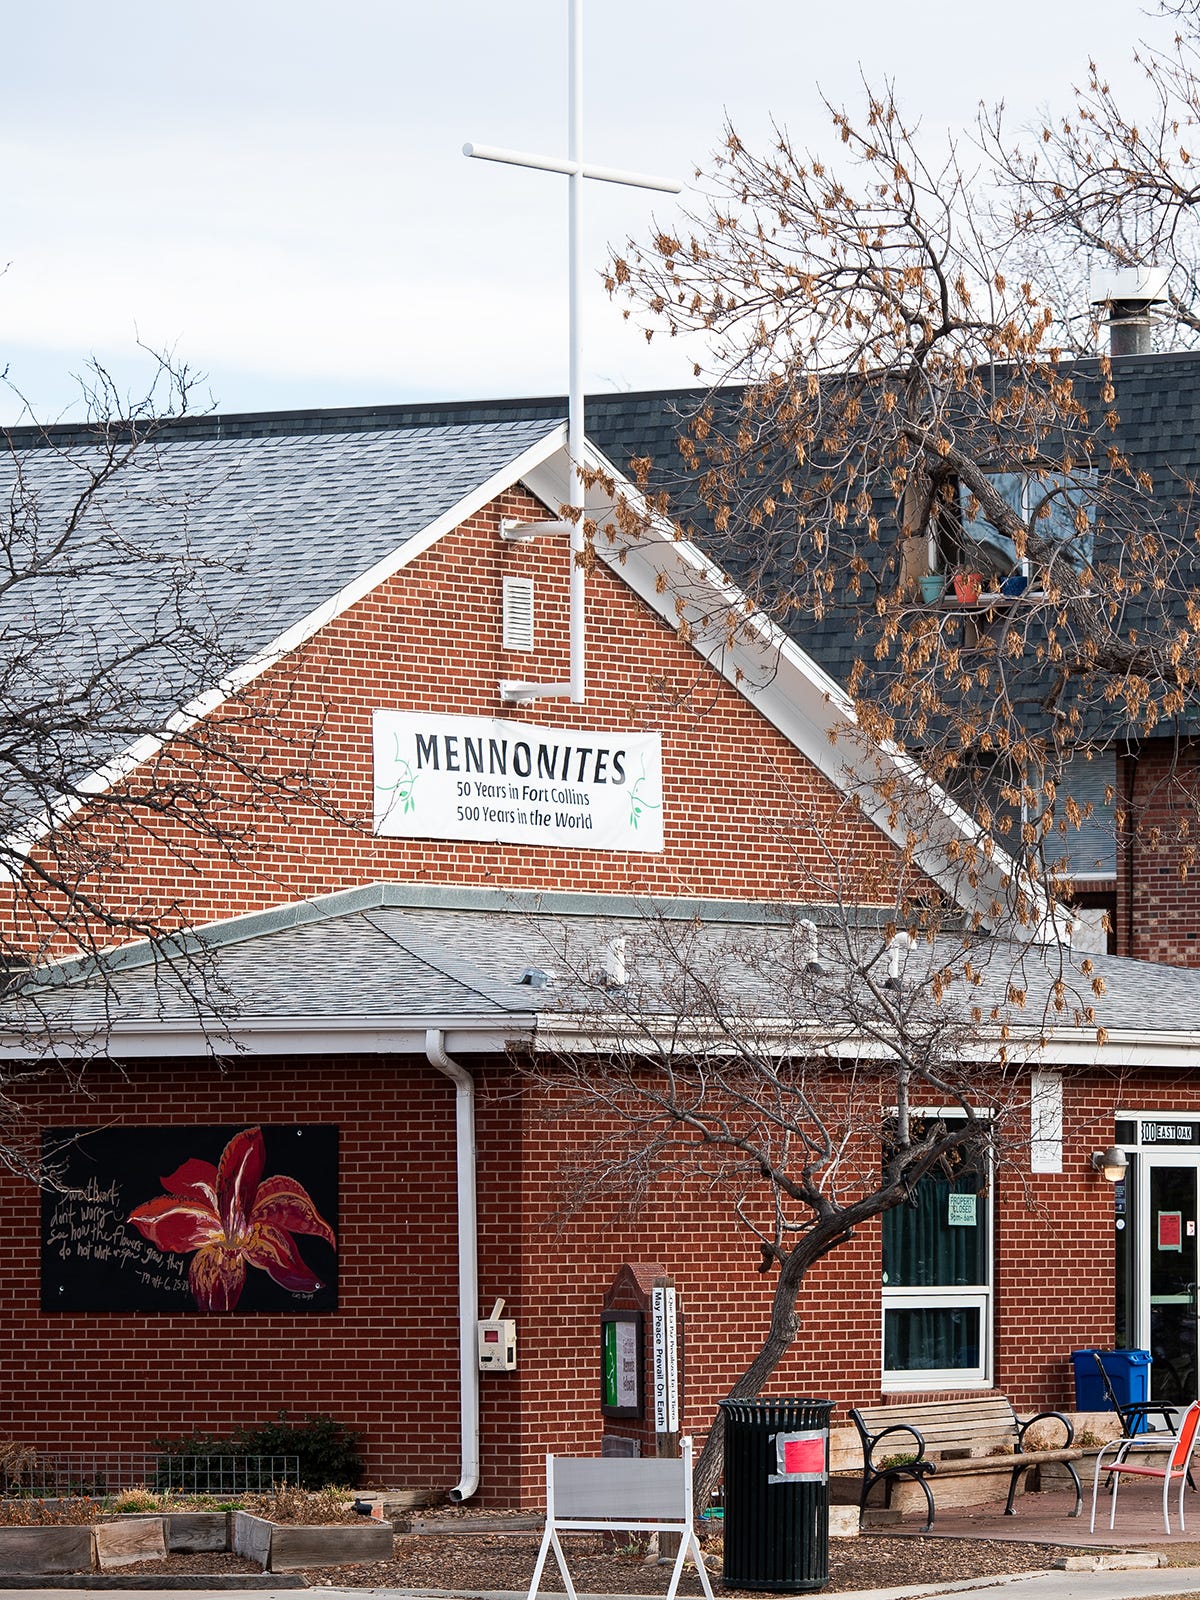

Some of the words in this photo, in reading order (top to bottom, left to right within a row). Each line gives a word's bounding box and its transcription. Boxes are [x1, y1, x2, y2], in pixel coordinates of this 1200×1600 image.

[415, 733, 626, 785] MENNONITES
[457, 781, 471, 797] 50
[474, 781, 507, 799] Years
[508, 783, 519, 800] in
[522, 785, 549, 802] Fort
[551, 788, 590, 806] Collins
[457, 806, 480, 821] 500
[482, 806, 515, 824] Years
[517, 808, 528, 825] in
[530, 809, 551, 827] the
[555, 812, 593, 830] World
[1158, 1127, 1175, 1138] EAST
[1178, 1127, 1192, 1138] OAK
[950, 1196, 975, 1205] PROPERTY
[952, 1205, 972, 1213] CLOSED
[81, 1206, 113, 1228] worry
[47, 1229, 68, 1245] see
[70, 1221, 90, 1241] how
[91, 1222, 112, 1241] the
[166, 1254, 184, 1276] they
[60, 1240, 71, 1260] do
[77, 1241, 93, 1260] not
[654, 1292, 662, 1312] May
[655, 1315, 663, 1345] Peace
[656, 1348, 664, 1380] Prevail
[657, 1383, 664, 1397] On
[657, 1400, 665, 1426] Earth
